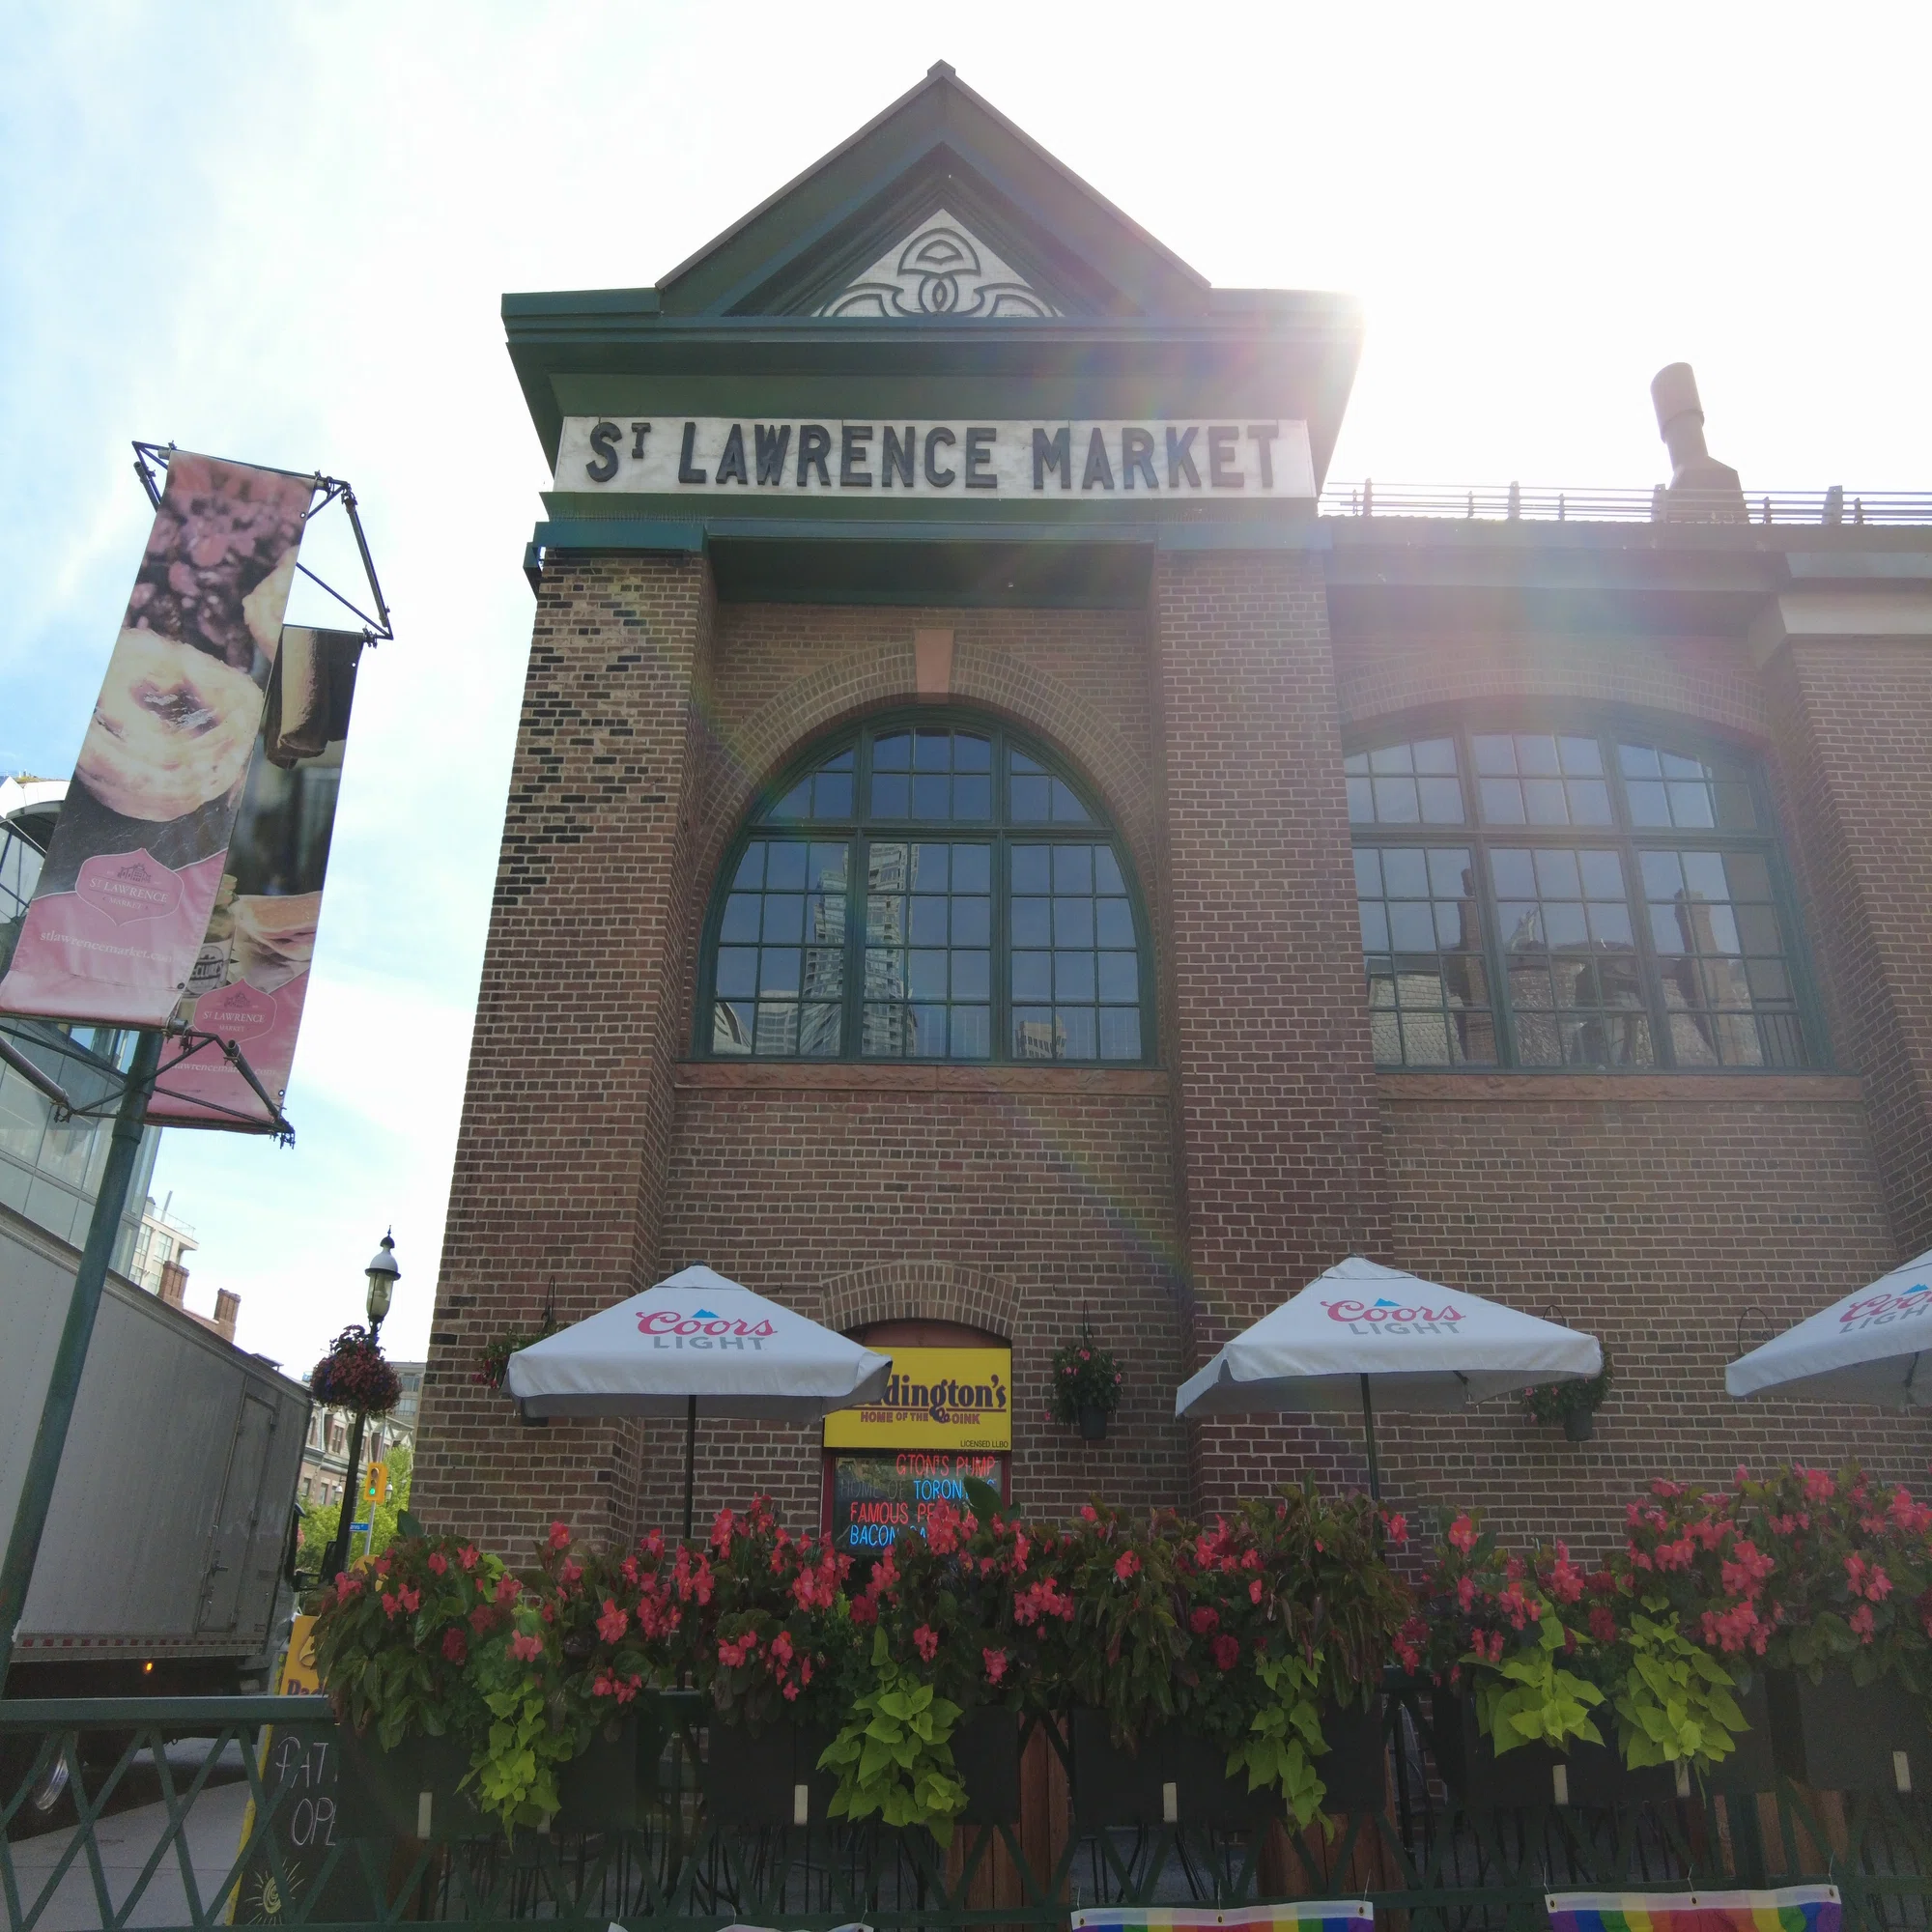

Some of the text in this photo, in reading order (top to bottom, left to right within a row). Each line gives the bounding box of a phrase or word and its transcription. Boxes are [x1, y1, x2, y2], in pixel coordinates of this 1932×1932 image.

[678, 421, 998, 489] LAWRENCE
[1032, 424, 1280, 490] MARKET
[103, 881, 169, 903] LAWRENCE
[108, 896, 143, 909] MARKET
[214, 1011, 266, 1023] LAWRENCE
[1320, 1298, 1466, 1323] Coors
[1839, 1291, 1932, 1322] Coo
[635, 1310, 779, 1338] Coors
[1349, 1321, 1461, 1336] LIGHT
[653, 1335, 768, 1350] LIGHT
[877, 1374, 1007, 1423] dington's
[860, 1410, 980, 1425] HOME OF THE OINK
[959, 1439, 1009, 1448] LICENSED LLBO
[955, 1456, 996, 1477] PUMP
[849, 1501, 909, 1524] FAMOUS
[275, 1736, 338, 1789] PAT
